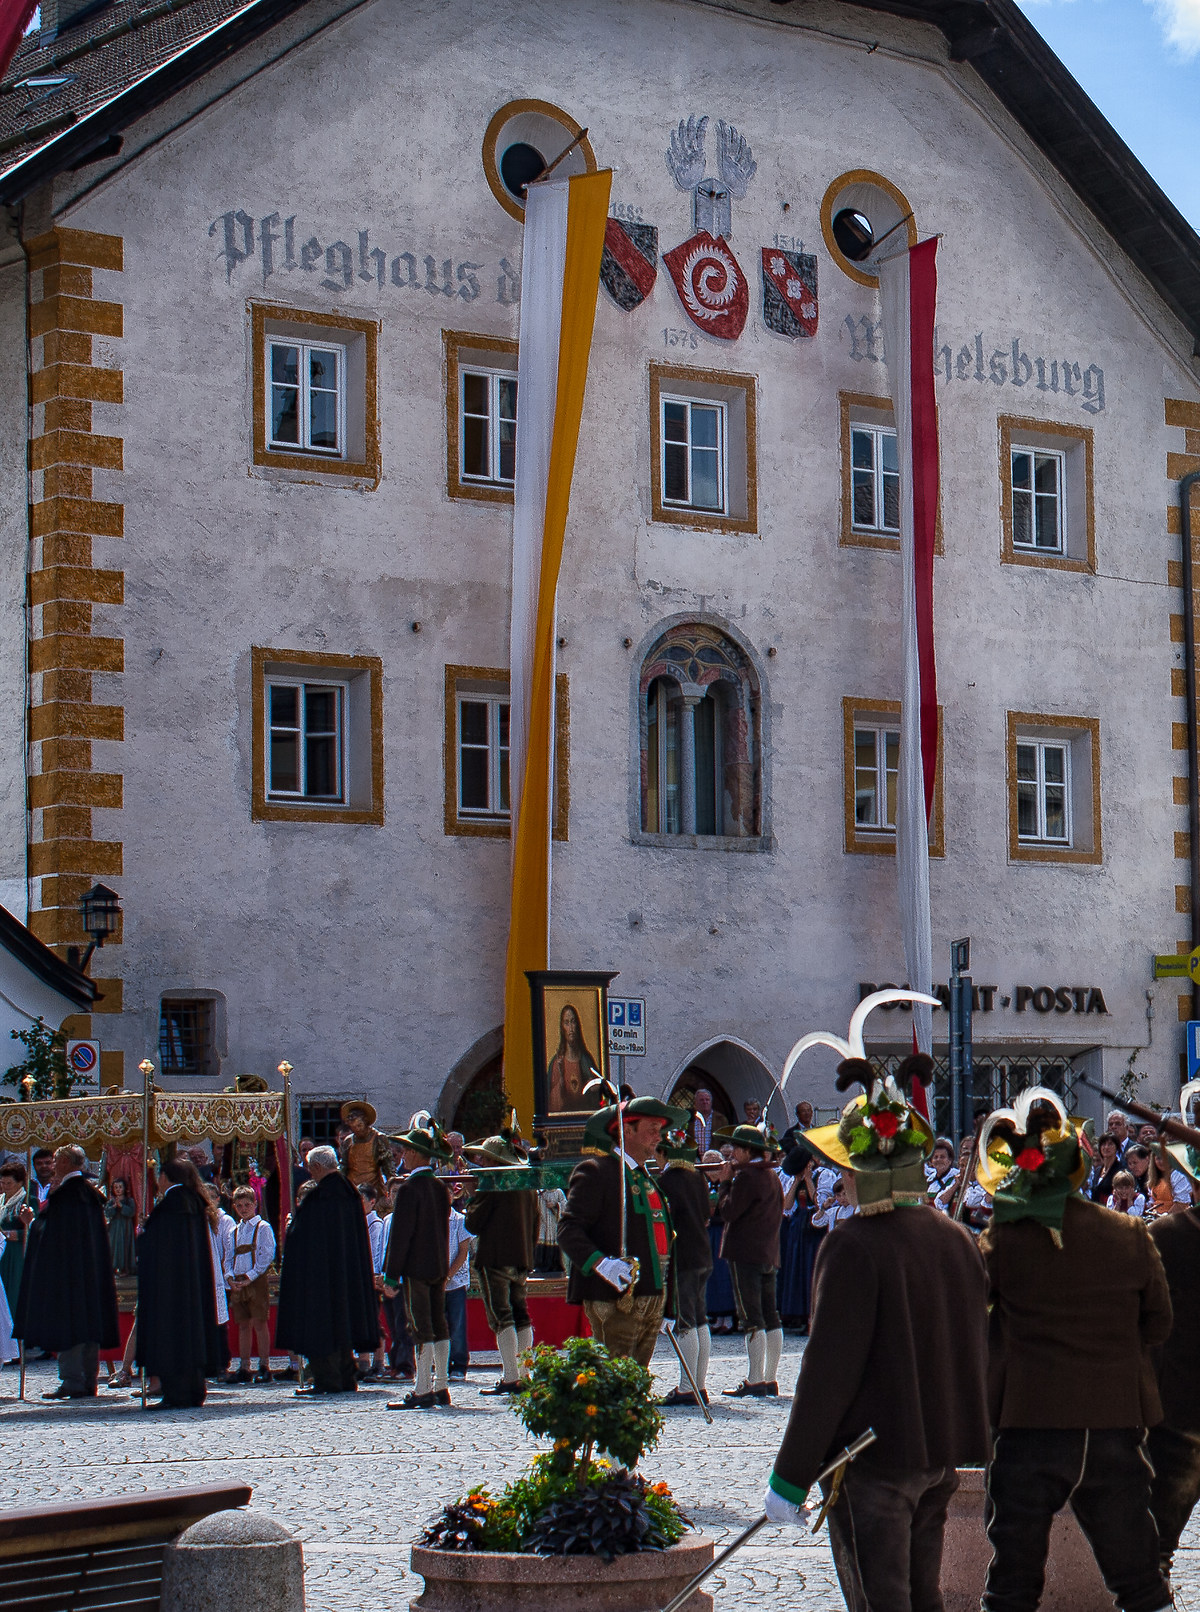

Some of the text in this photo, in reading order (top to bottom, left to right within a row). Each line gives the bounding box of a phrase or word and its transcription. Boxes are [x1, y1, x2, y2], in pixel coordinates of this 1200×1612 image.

[208, 208, 484, 302] Pfleghaus
[838, 312, 1106, 416] Mhelsburg
[1015, 985, 1109, 1013] POSTA
[612, 1004, 623, 1023] P
[612, 1028, 638, 1039] 60 min
